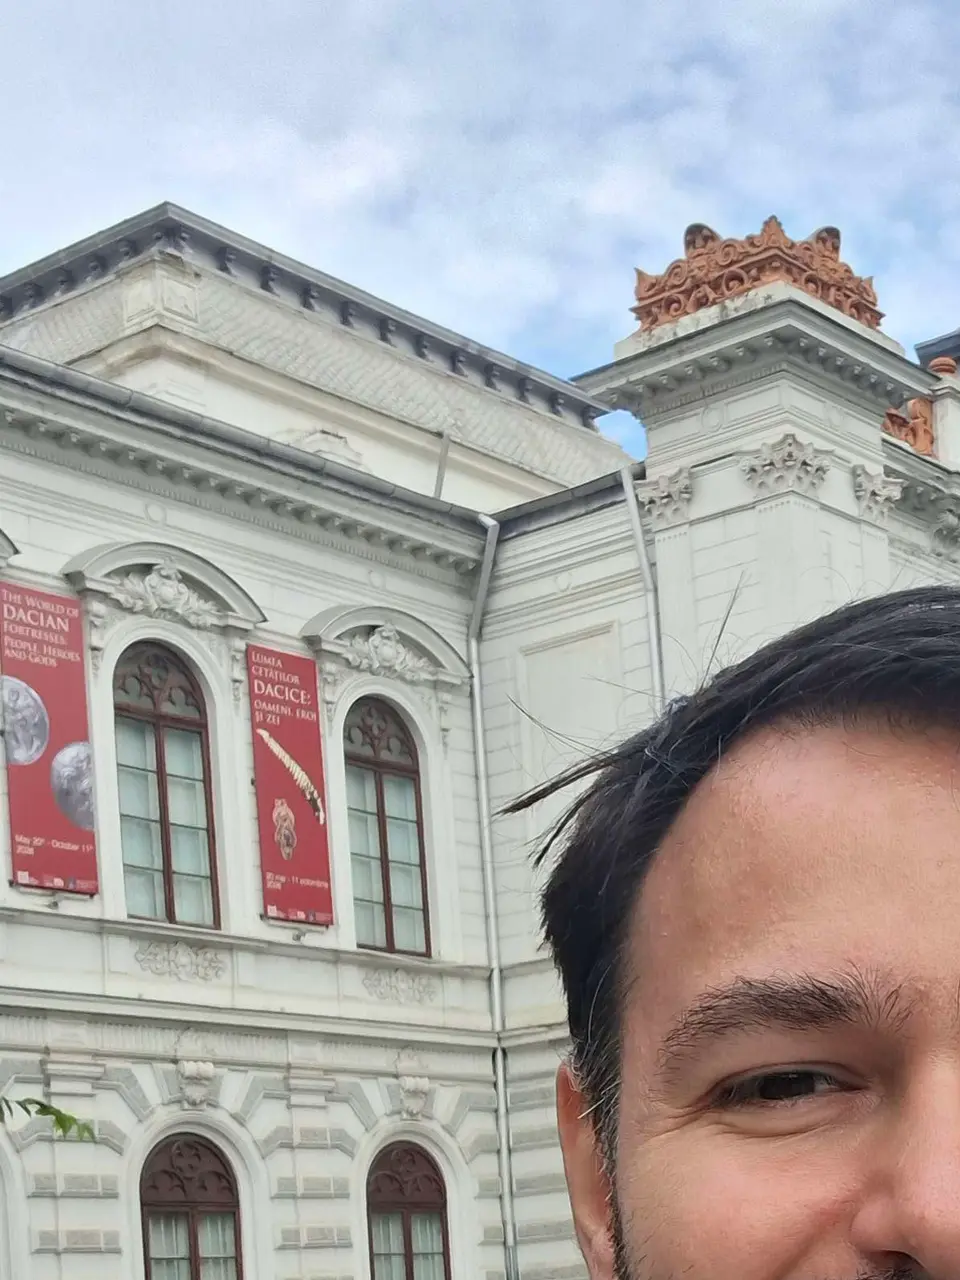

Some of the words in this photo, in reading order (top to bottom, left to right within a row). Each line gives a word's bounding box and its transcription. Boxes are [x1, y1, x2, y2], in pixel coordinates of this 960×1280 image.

[25, 595, 64, 614] WORLD
[3, 604, 69, 632] DACIAN
[4, 648, 25, 661] AND
[28, 652, 57, 667] GODS
[43, 645, 80, 662] HEROES
[252, 651, 282, 668] LUMEA
[266, 714, 280, 726] ZEI
[296, 708, 316, 723] EROI
[51, 839, 79, 851] October
